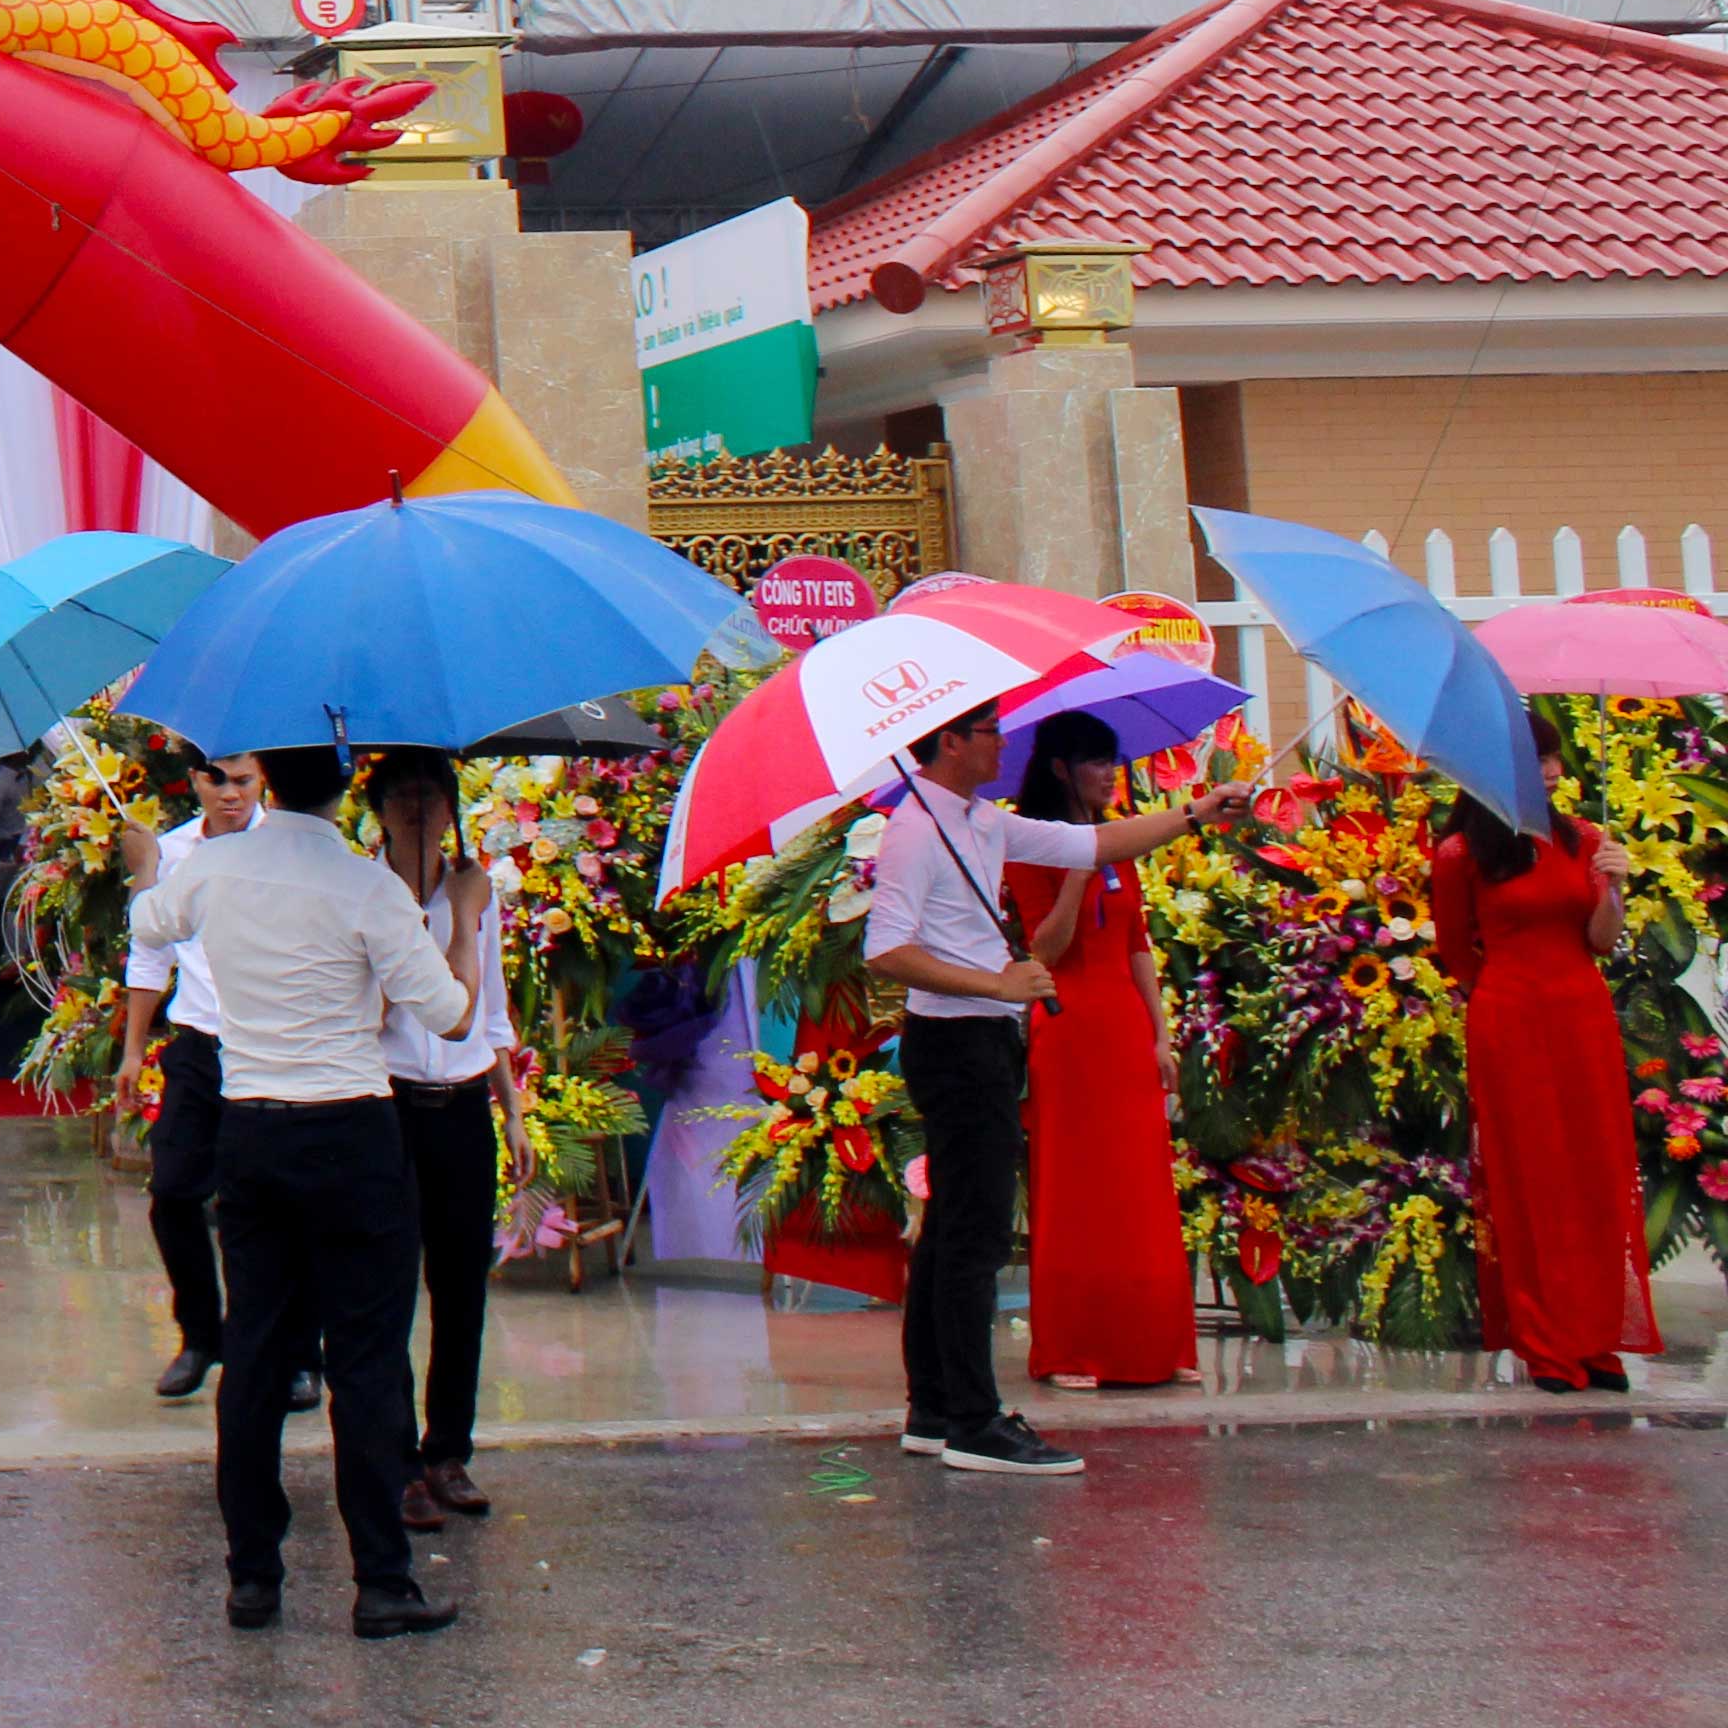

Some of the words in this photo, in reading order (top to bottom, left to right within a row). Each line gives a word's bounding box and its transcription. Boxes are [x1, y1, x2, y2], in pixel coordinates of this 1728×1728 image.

[761, 573, 802, 605] CÔNG
[804, 581, 821, 605] TY
[825, 580, 855, 607] EITS
[768, 615, 810, 636] CHÚC
[865, 679, 968, 737] HONDA
